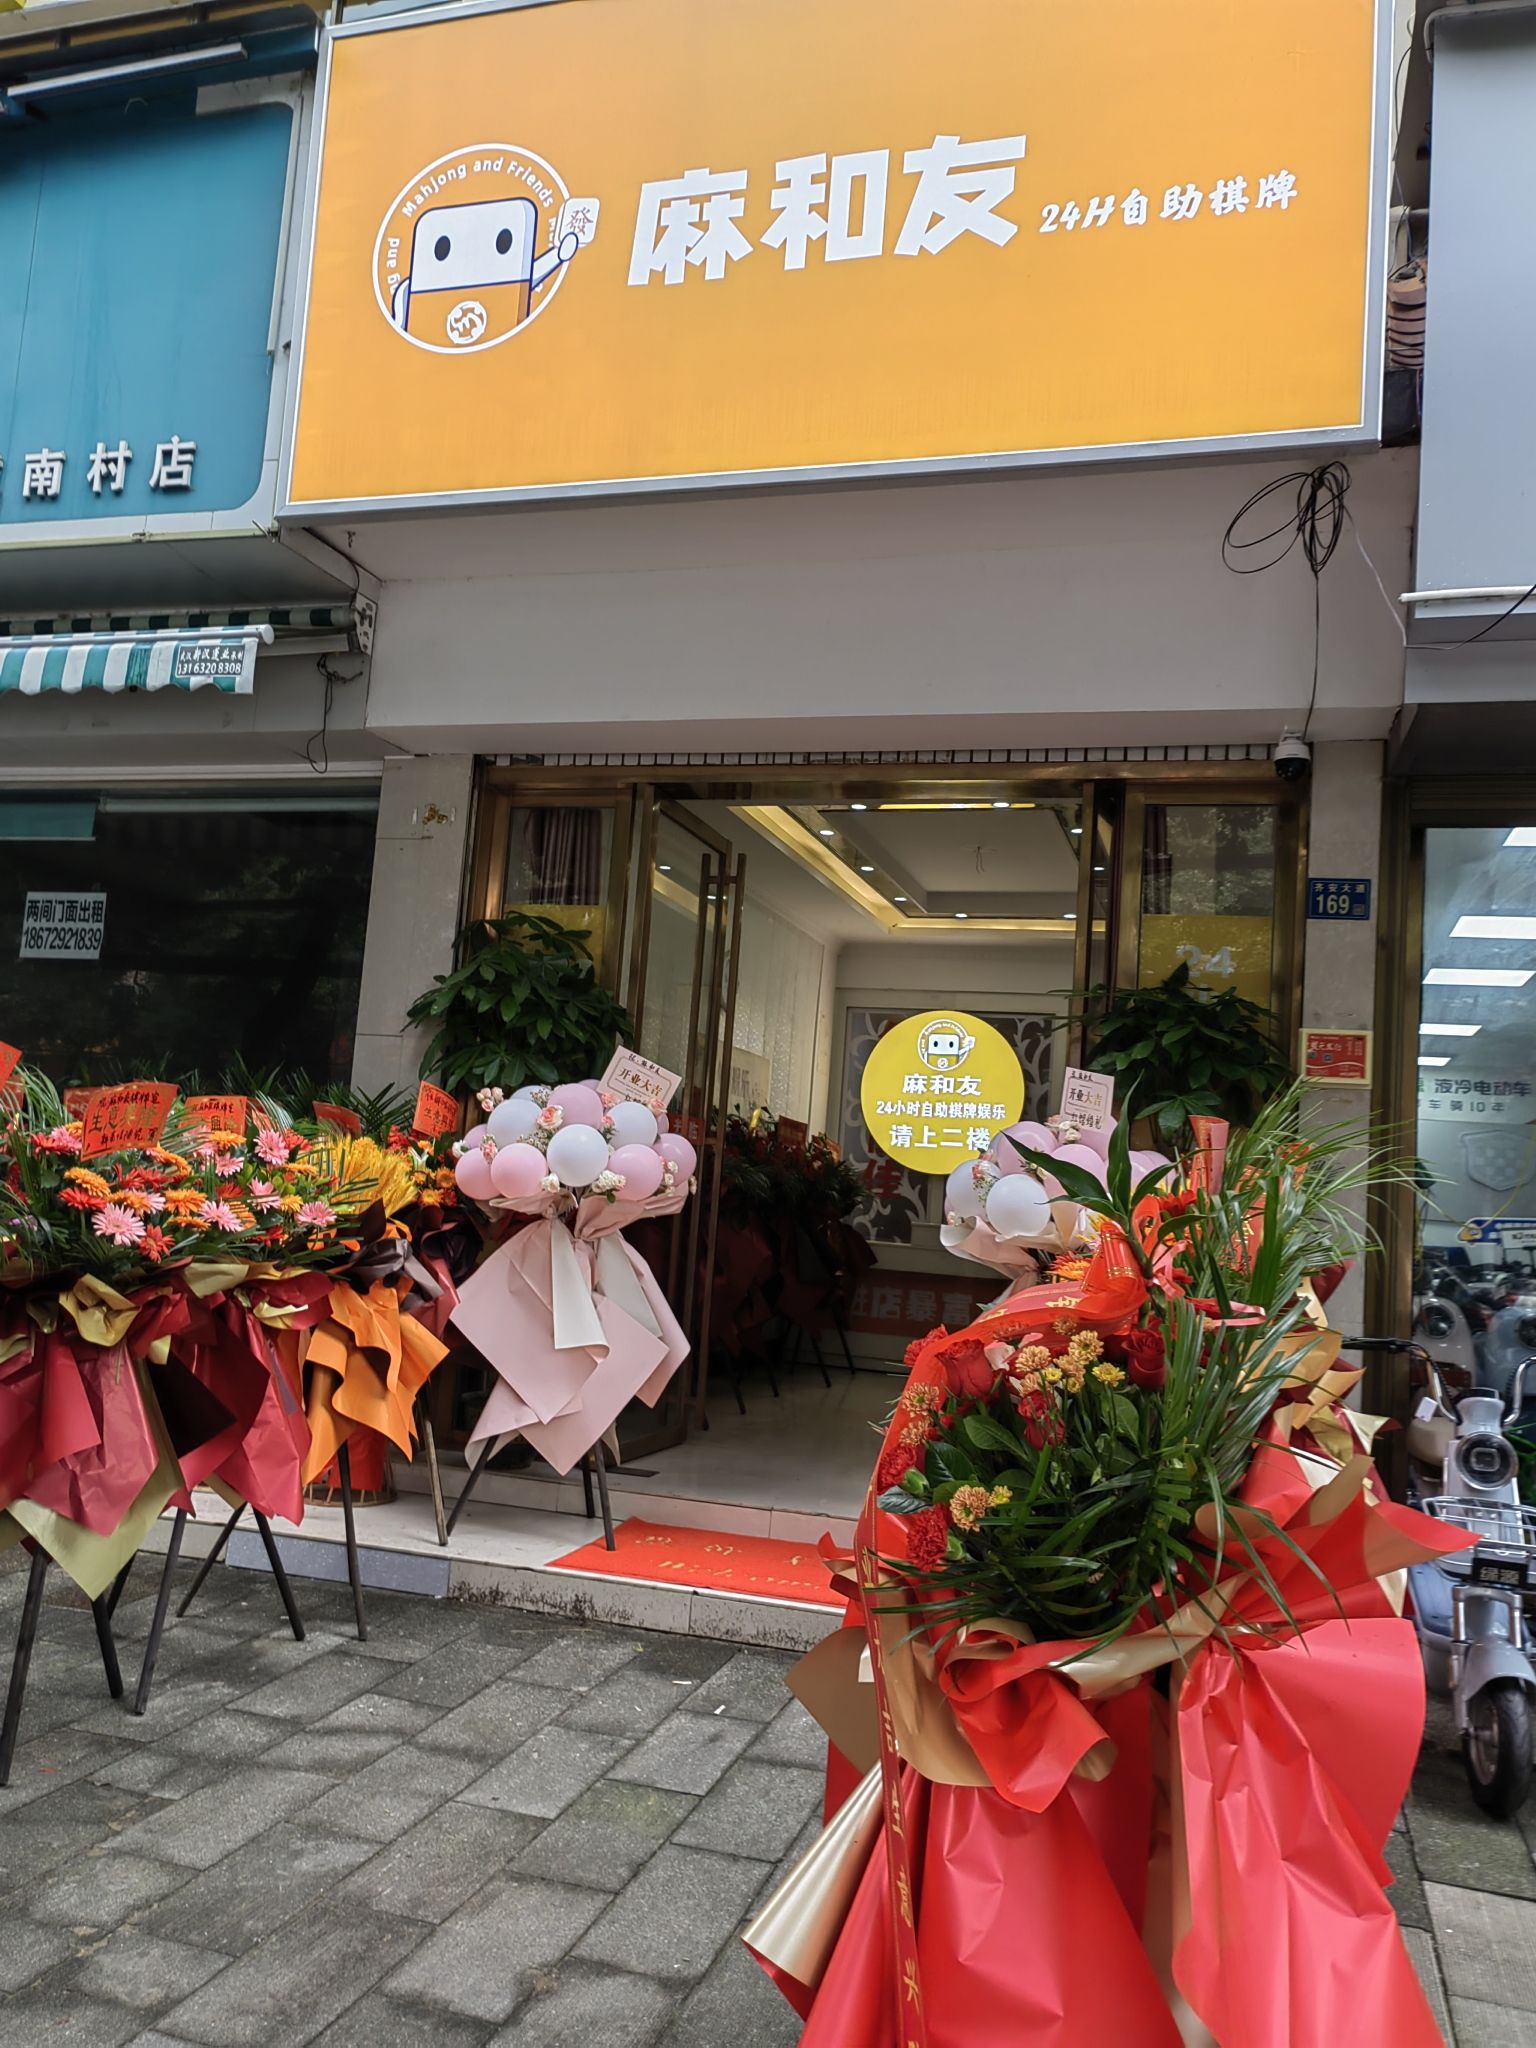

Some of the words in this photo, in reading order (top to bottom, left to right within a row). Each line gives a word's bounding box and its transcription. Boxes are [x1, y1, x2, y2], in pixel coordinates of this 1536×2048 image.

[403, 163, 468, 217] Mahjong
[473, 156, 503, 173] and
[508, 161, 553, 208] Friends
[627, 135, 1027, 287] 麻和友
[1040, 169, 1298, 233] 24H自助棋牌
[386, 236, 400, 269] and
[0, 435, 197, 500] 南村店
[26, 899, 104, 923] 两间门面出租
[1316, 894, 1350, 914] 169
[24, 926, 101, 950] 18672921839
[619, 1068, 663, 1096] 开业大吉
[902, 1073, 983, 1096] 麻和友
[876, 1100, 1006, 1120] 24小时自助棋牌娱乐
[889, 1124, 991, 1151] 请上二楼
